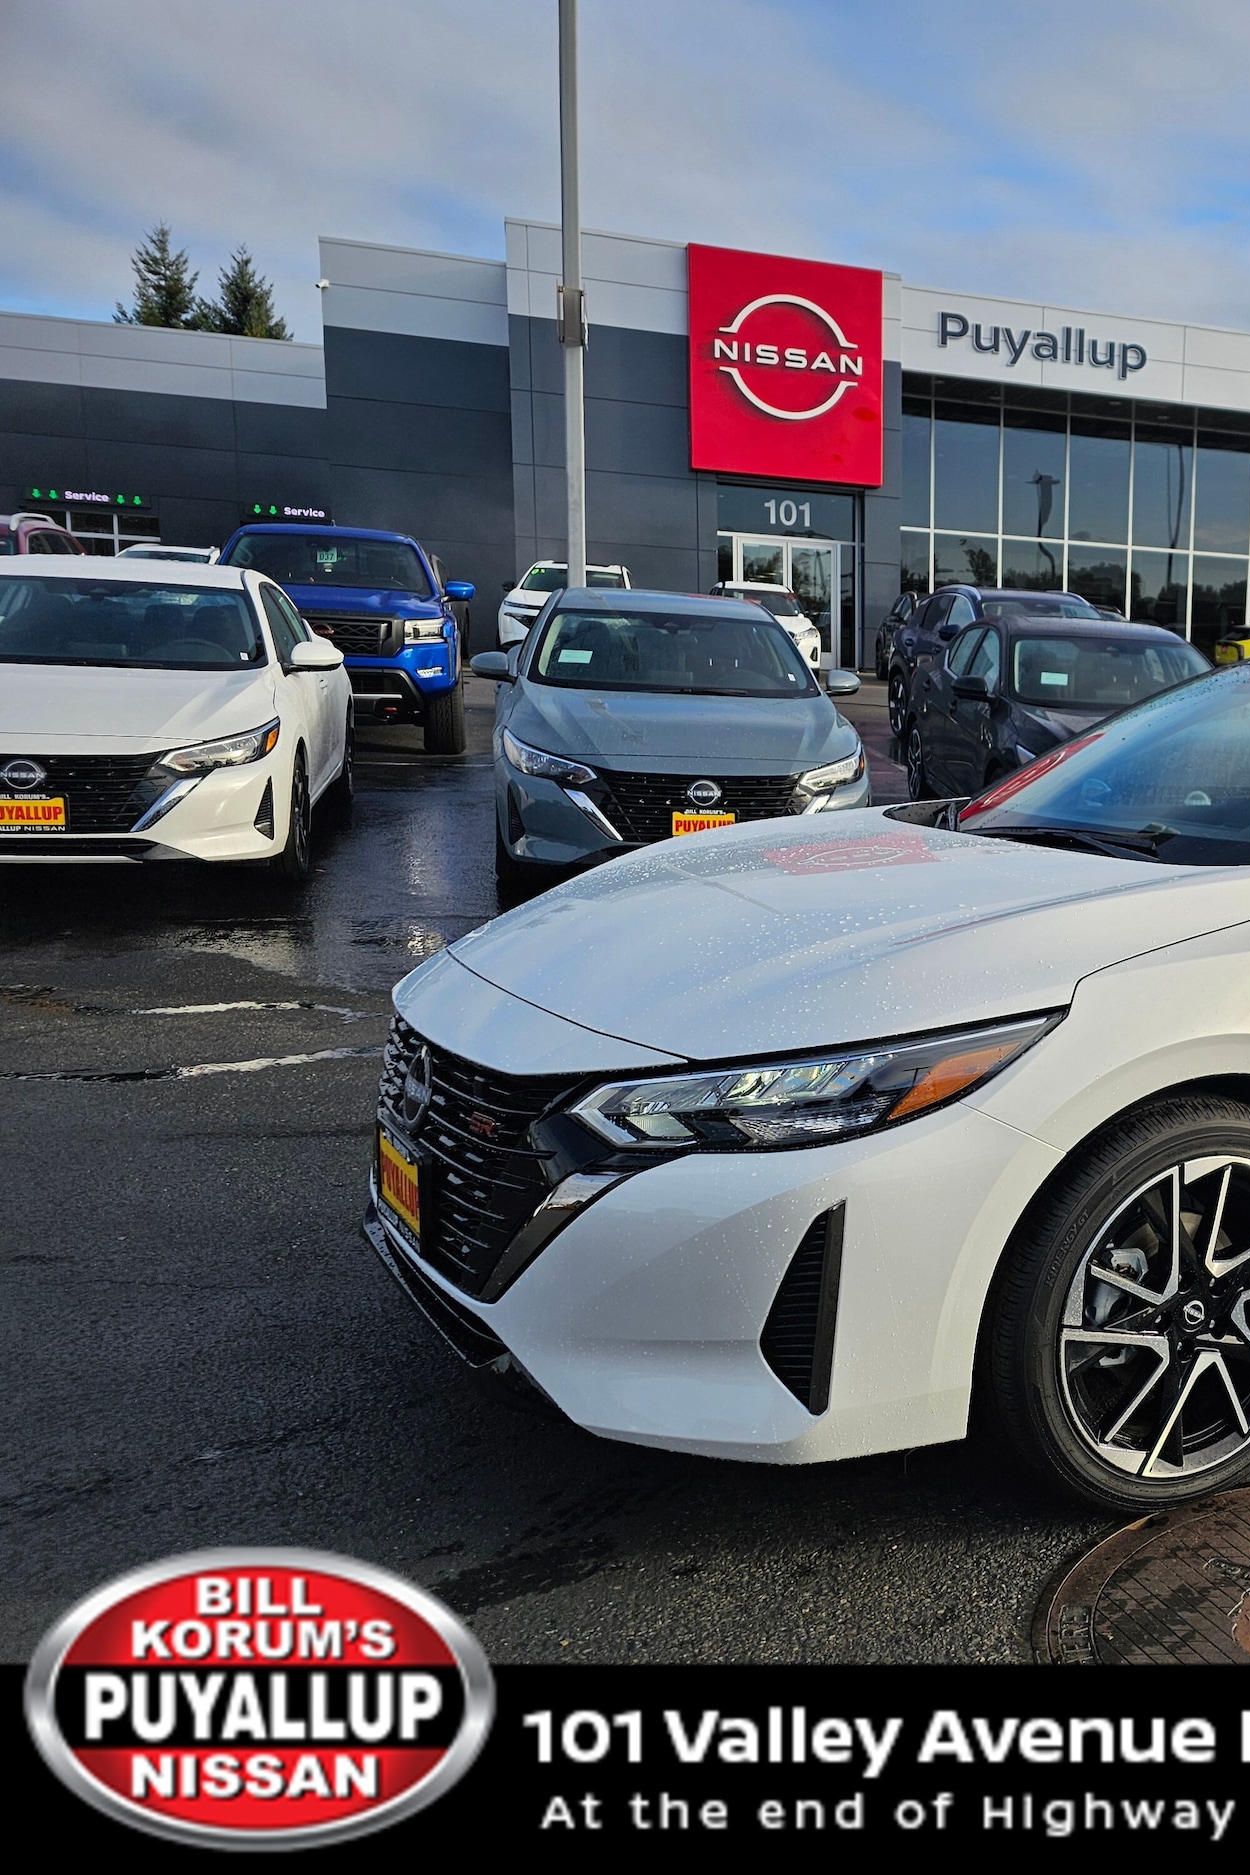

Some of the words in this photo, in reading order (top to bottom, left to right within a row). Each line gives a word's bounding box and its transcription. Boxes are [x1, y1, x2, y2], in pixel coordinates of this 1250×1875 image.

[938, 311, 1147, 380] Puyallup
[714, 338, 863, 375] NISSAN
[64, 490, 110, 502] Service
[283, 506, 325, 518] Service
[764, 499, 811, 527] 101
[0, 771, 46, 779] NISSAN
[0, 806, 63, 820] YALLUP
